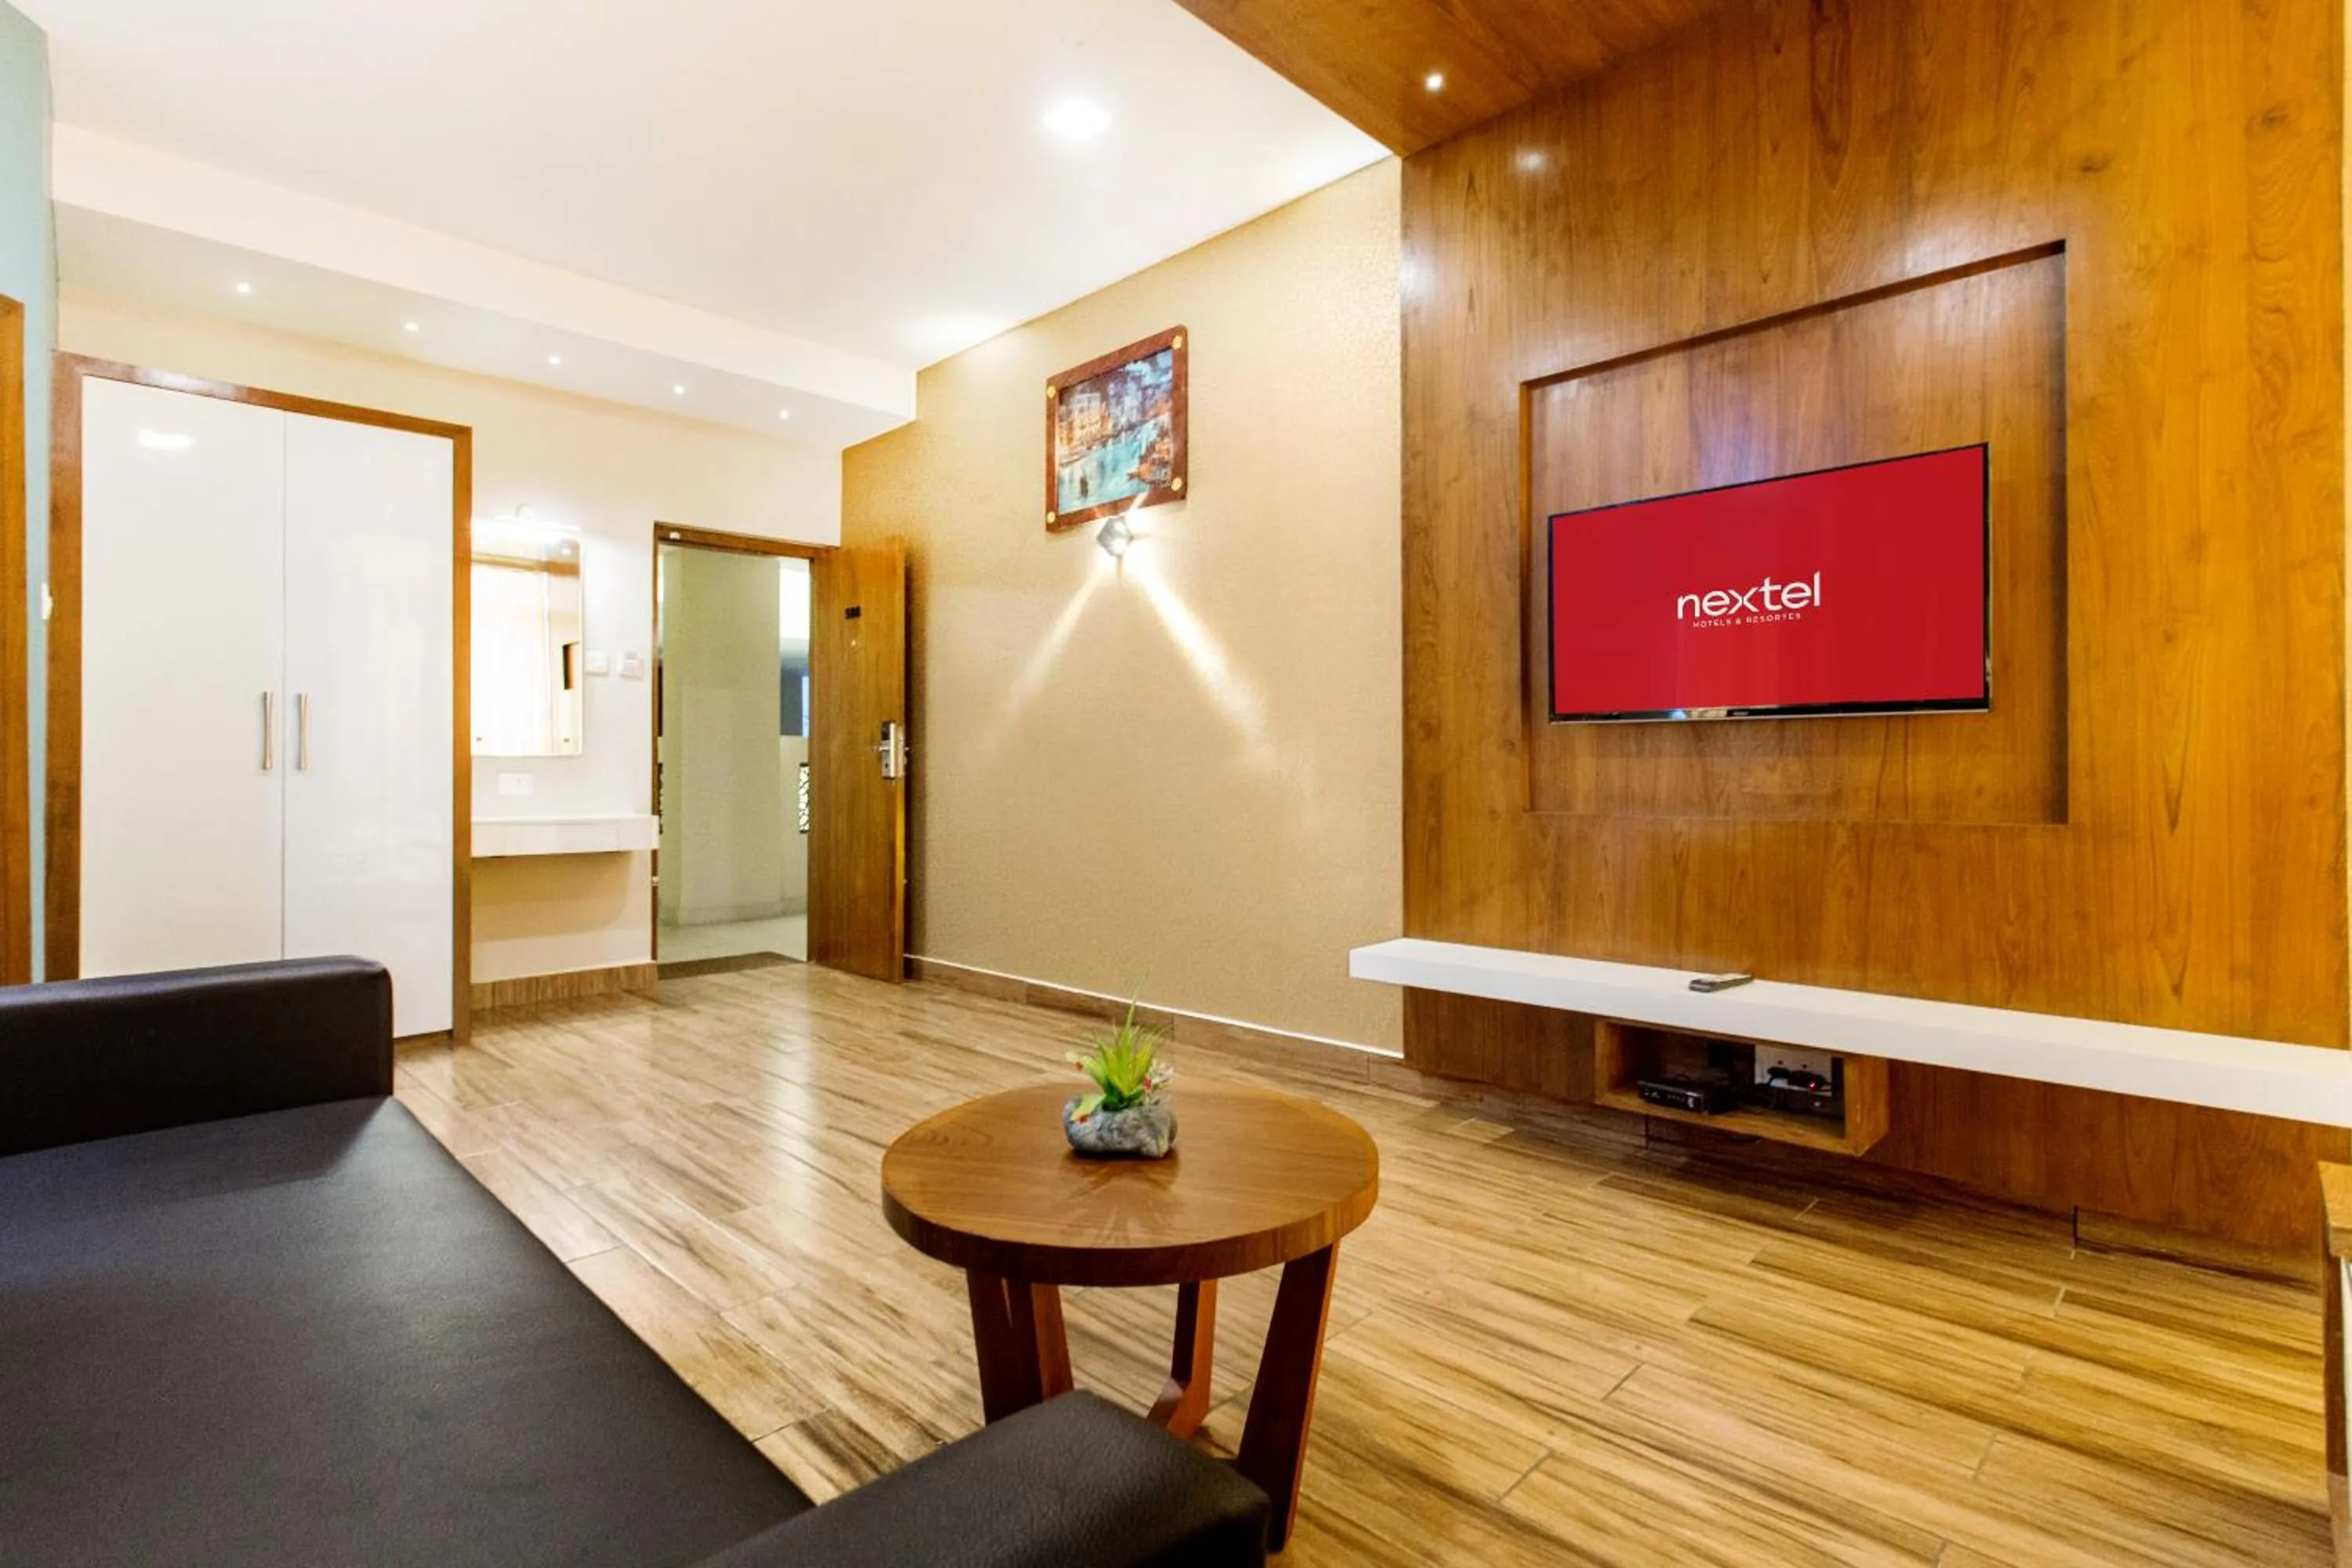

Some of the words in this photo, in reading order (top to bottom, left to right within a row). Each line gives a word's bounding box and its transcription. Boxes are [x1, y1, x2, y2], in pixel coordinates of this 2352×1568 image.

[1677, 570, 1820, 619] nextel
[1693, 618, 1732, 628] HOTELS
[1735, 616, 1742, 626] &
